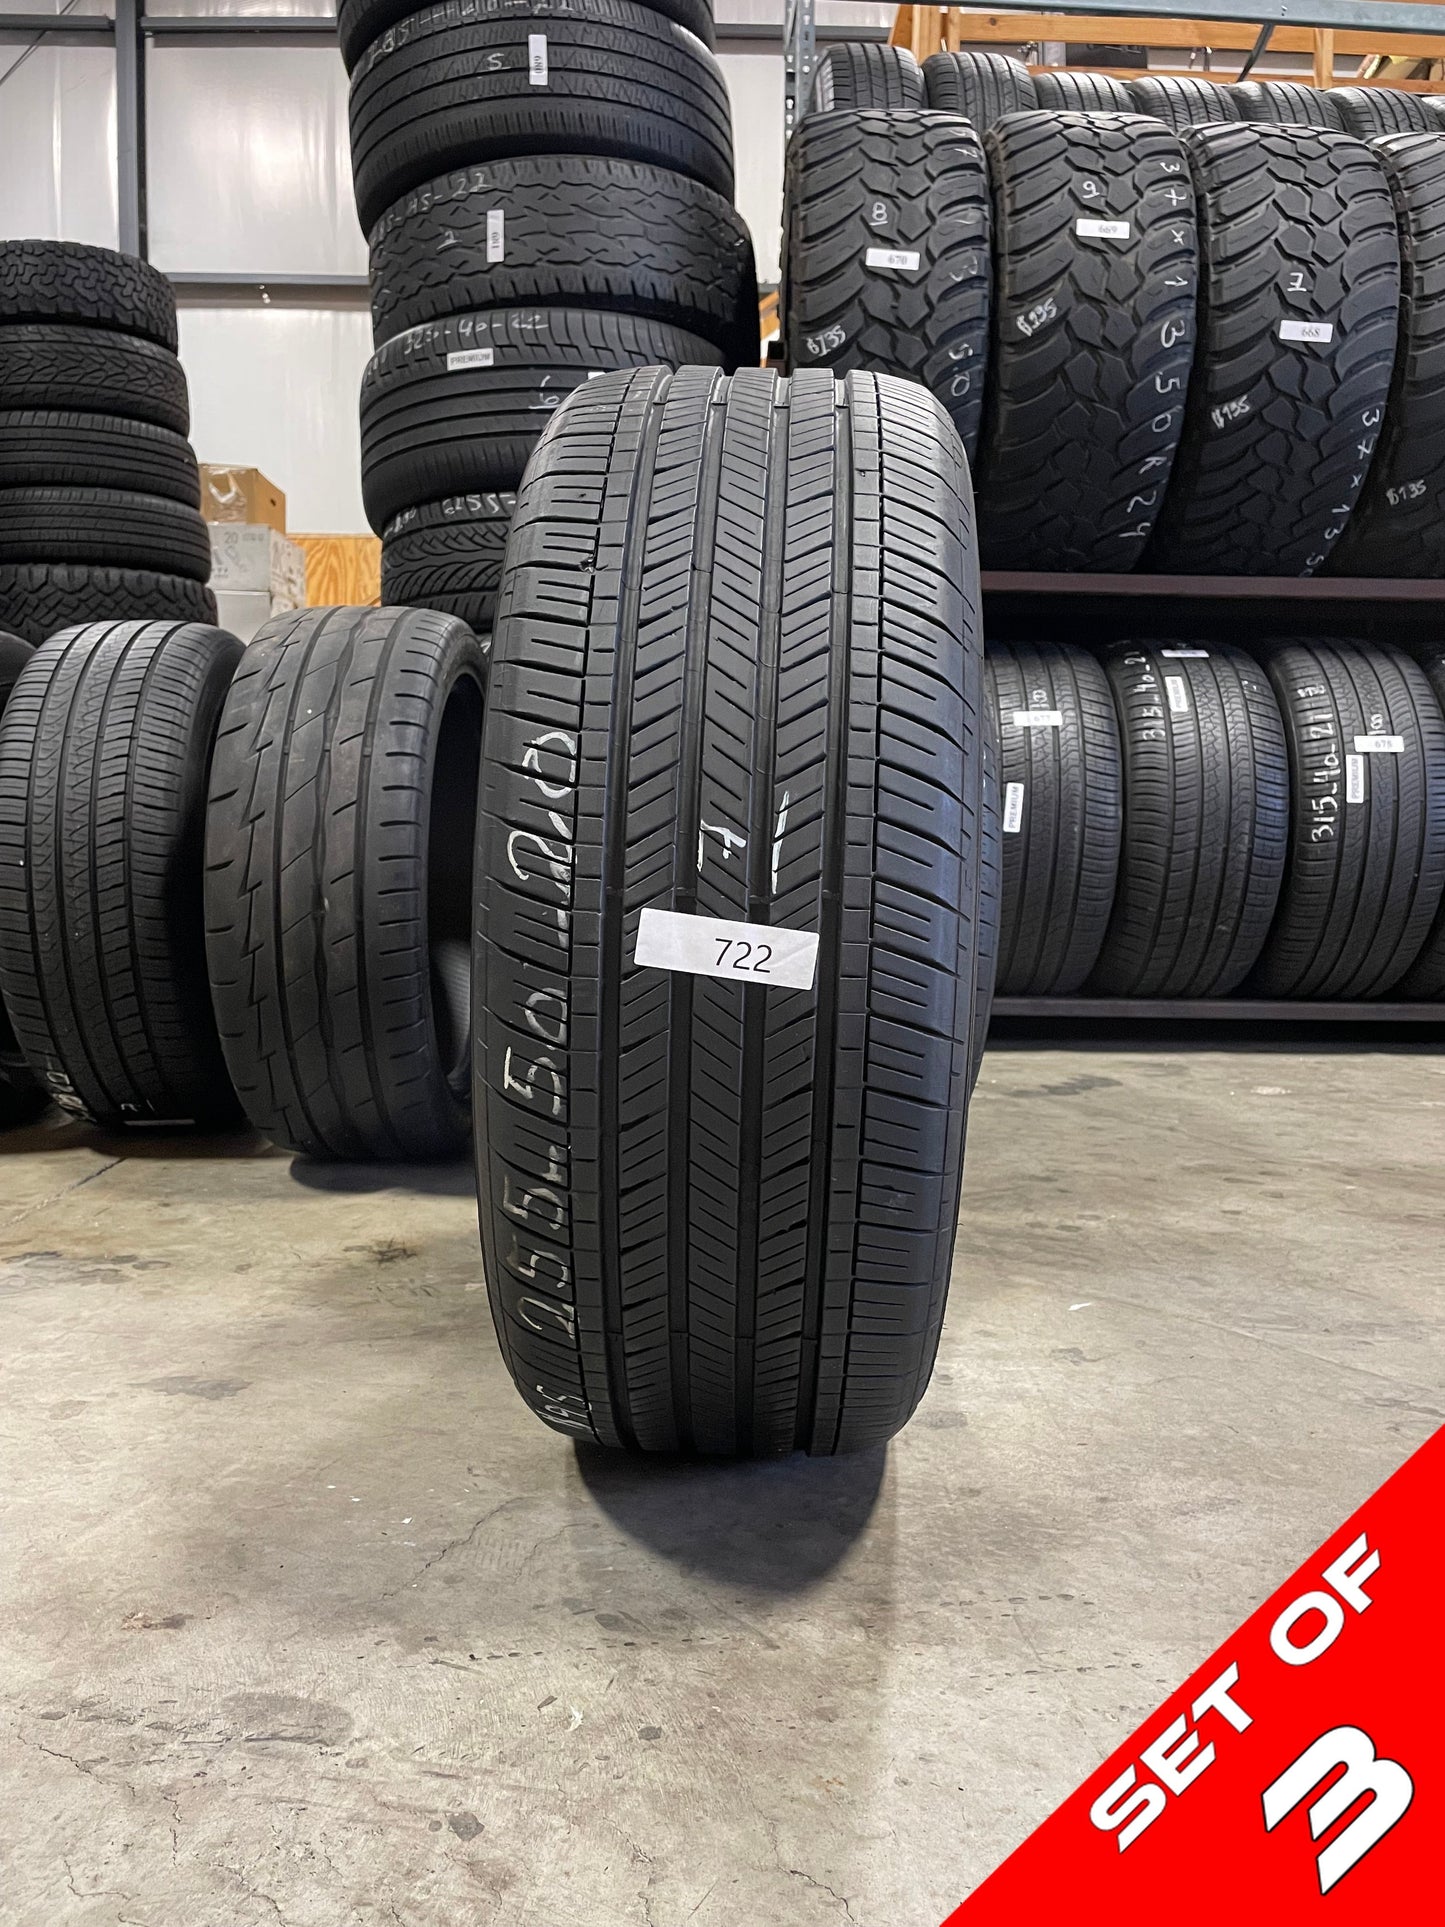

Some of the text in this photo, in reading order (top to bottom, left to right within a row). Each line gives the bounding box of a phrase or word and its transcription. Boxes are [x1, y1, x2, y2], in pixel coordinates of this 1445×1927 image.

[872, 202, 888, 223] 8
[450, 352, 492, 365] PREMIUM
[1311, 713, 1341, 842] 315-40-21
[1350, 757, 1360, 800] PREMIUM
[1008, 785, 1020, 829] PREMIUM
[714, 937, 773, 974] 722
